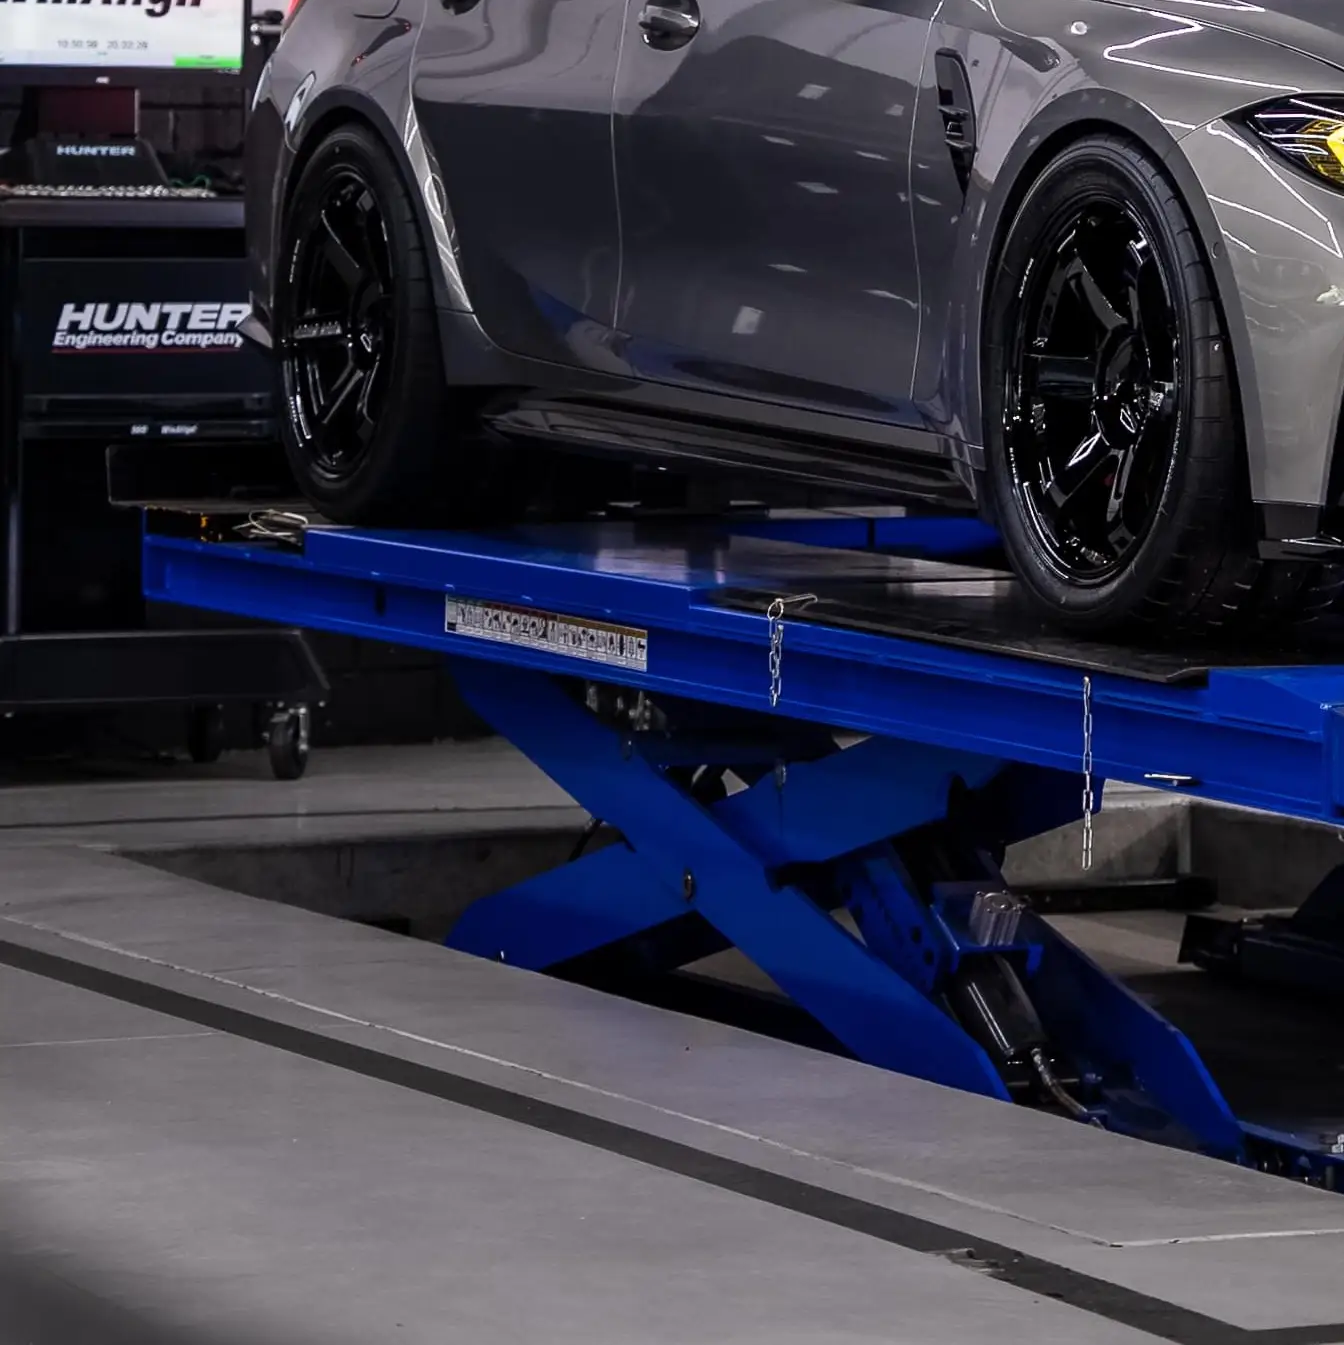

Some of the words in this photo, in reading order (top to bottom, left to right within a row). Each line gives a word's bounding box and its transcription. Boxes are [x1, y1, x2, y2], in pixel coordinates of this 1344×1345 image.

[57, 145, 135, 156] HUNTER
[57, 302, 251, 331] HUNTER
[53, 331, 159, 349] Engineering
[161, 330, 244, 348] Company
